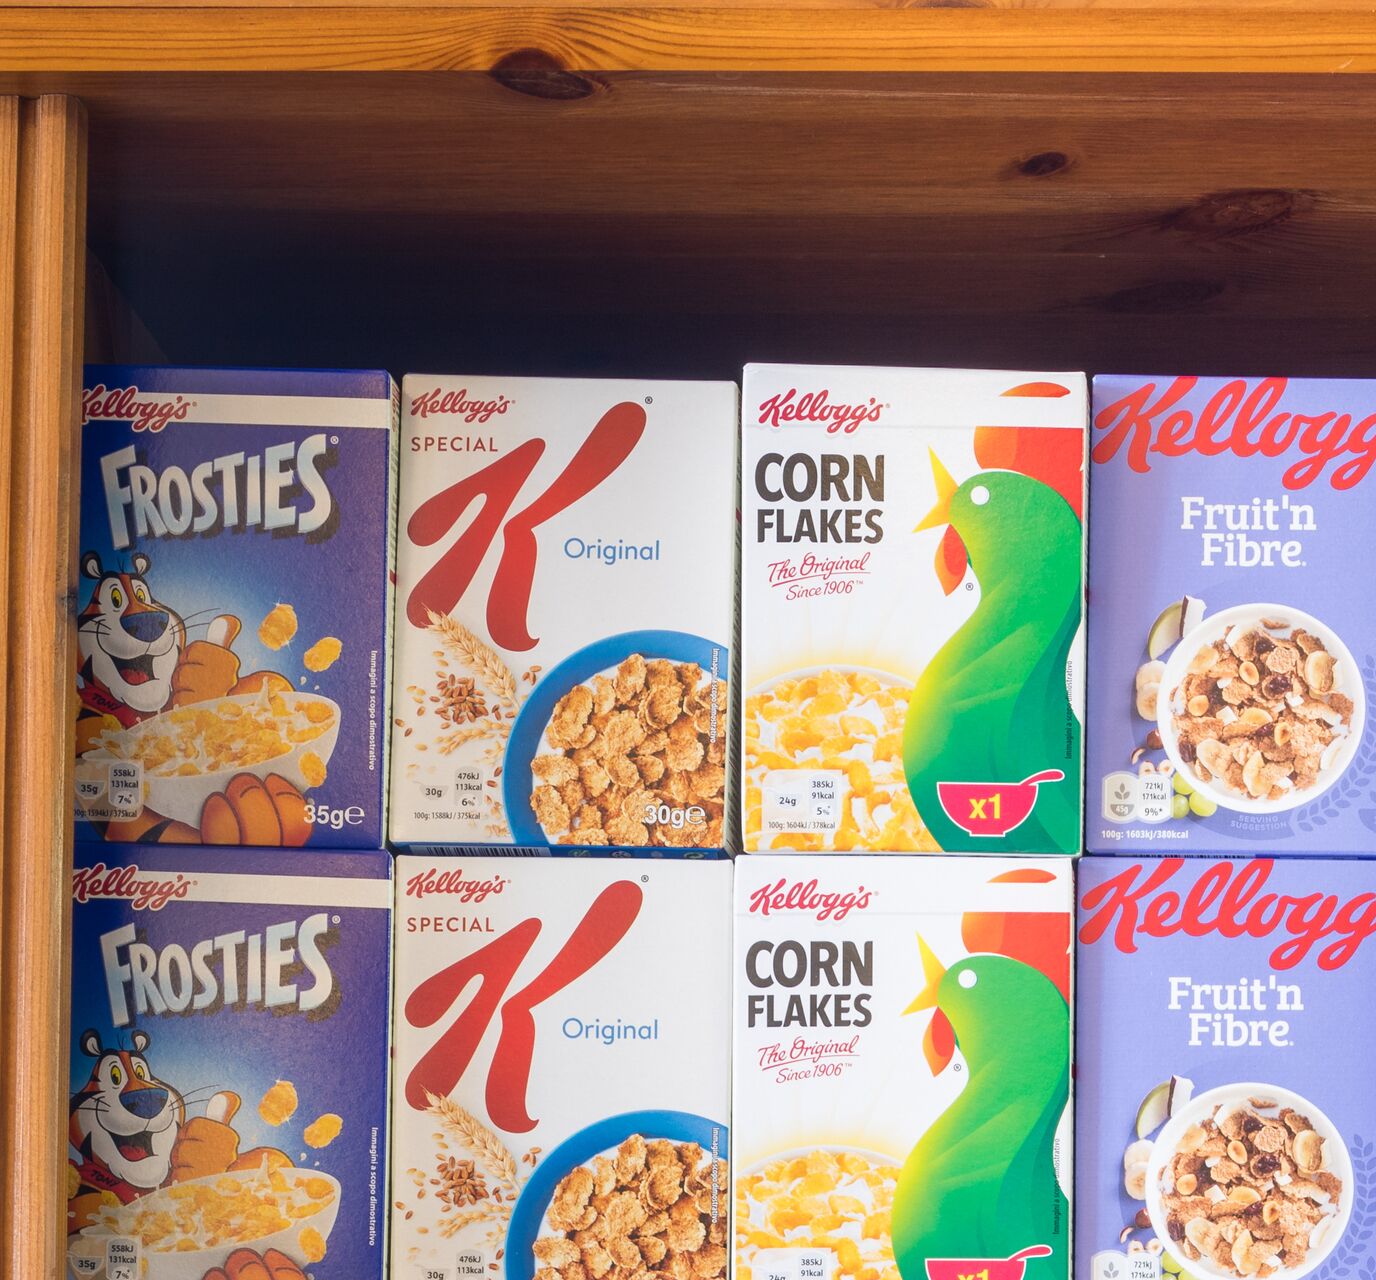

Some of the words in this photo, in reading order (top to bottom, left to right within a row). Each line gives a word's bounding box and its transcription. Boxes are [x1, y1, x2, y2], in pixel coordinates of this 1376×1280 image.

[410, 388, 510, 423] Kellogg's
[758, 388, 884, 434] Kellogg's
[411, 436, 498, 452] SPECIAL
[754, 453, 885, 502] CORN
[100, 433, 332, 550] FROSTIES
[406, 401, 647, 652] K
[757, 509, 884, 544] FLAKES
[564, 537, 660, 565] Original
[767, 559, 797, 582] The
[800, 552, 872, 580] Original
[786, 581, 822, 601] Since
[369, 650, 378, 688] Immagini
[368, 719, 378, 770] dimostrativo
[111, 780, 139, 789] 131kcal
[113, 769, 136, 778] 558kJ
[80, 784, 98, 797] 35g
[425, 788, 443, 797] 30g
[455, 783, 482, 791] 113kcal
[1142, 793, 1167, 801] 171kcal
[1145, 782, 1164, 790] 721kJ
[779, 796, 797, 806] 24g
[968, 793, 1001, 819] x1
[1101, 830, 1124, 841] 100g:
[73, 863, 189, 910] Kellogg's
[405, 868, 505, 903] Kellogg's
[749, 878, 872, 921] Kellogg's
[406, 917, 495, 932] SPECIAL
[99, 913, 333, 1029] FROSTIES
[745, 940, 874, 988] CORN
[404, 879, 644, 1134] K
[748, 993, 873, 1028] FLAKES
[562, 1017, 659, 1045] Original
[758, 1043, 787, 1066] The
[790, 1034, 860, 1063] Original
[775, 1067, 812, 1084] Since
[370, 1127, 379, 1166] Immagini
[369, 1171, 377, 1194] scopo
[368, 1195, 377, 1246] dimostrativo
[78, 1260, 96, 1270] 35g
[108, 1255, 137, 1263] 131kcal
[457, 1266, 484, 1274] 113kcal
[459, 1255, 481, 1263] 476kJ
[801, 1258, 823, 1266] 385kJ
[1134, 1261, 1152, 1269] 721kJ
[427, 1271, 444, 1280] 30g
[800, 1269, 824, 1277] 91kcal
